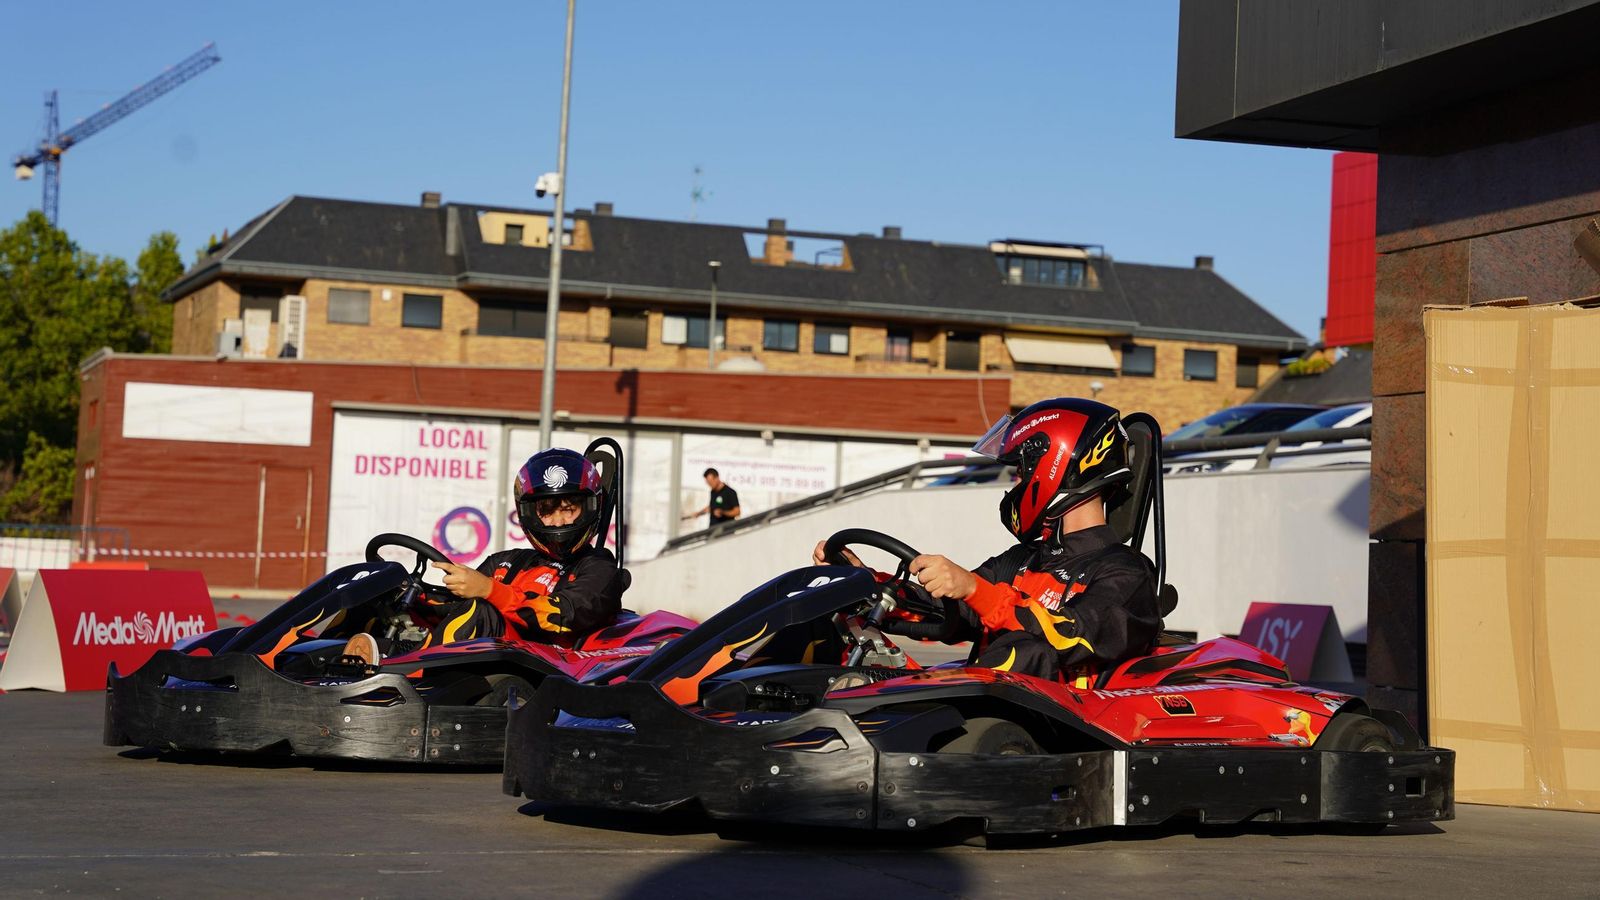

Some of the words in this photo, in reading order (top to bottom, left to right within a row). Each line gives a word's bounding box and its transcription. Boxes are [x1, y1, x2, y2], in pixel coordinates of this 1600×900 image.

[418, 427, 487, 450] LOCAL
[1011, 424, 1031, 441] Media
[1036, 413, 1059, 425] Markt
[355, 454, 487, 480] DISPONIBLE
[1048, 466, 1058, 481] ALEX
[72, 611, 136, 646] Media
[153, 611, 206, 644] Markt
[1258, 617, 1304, 661] ISY
